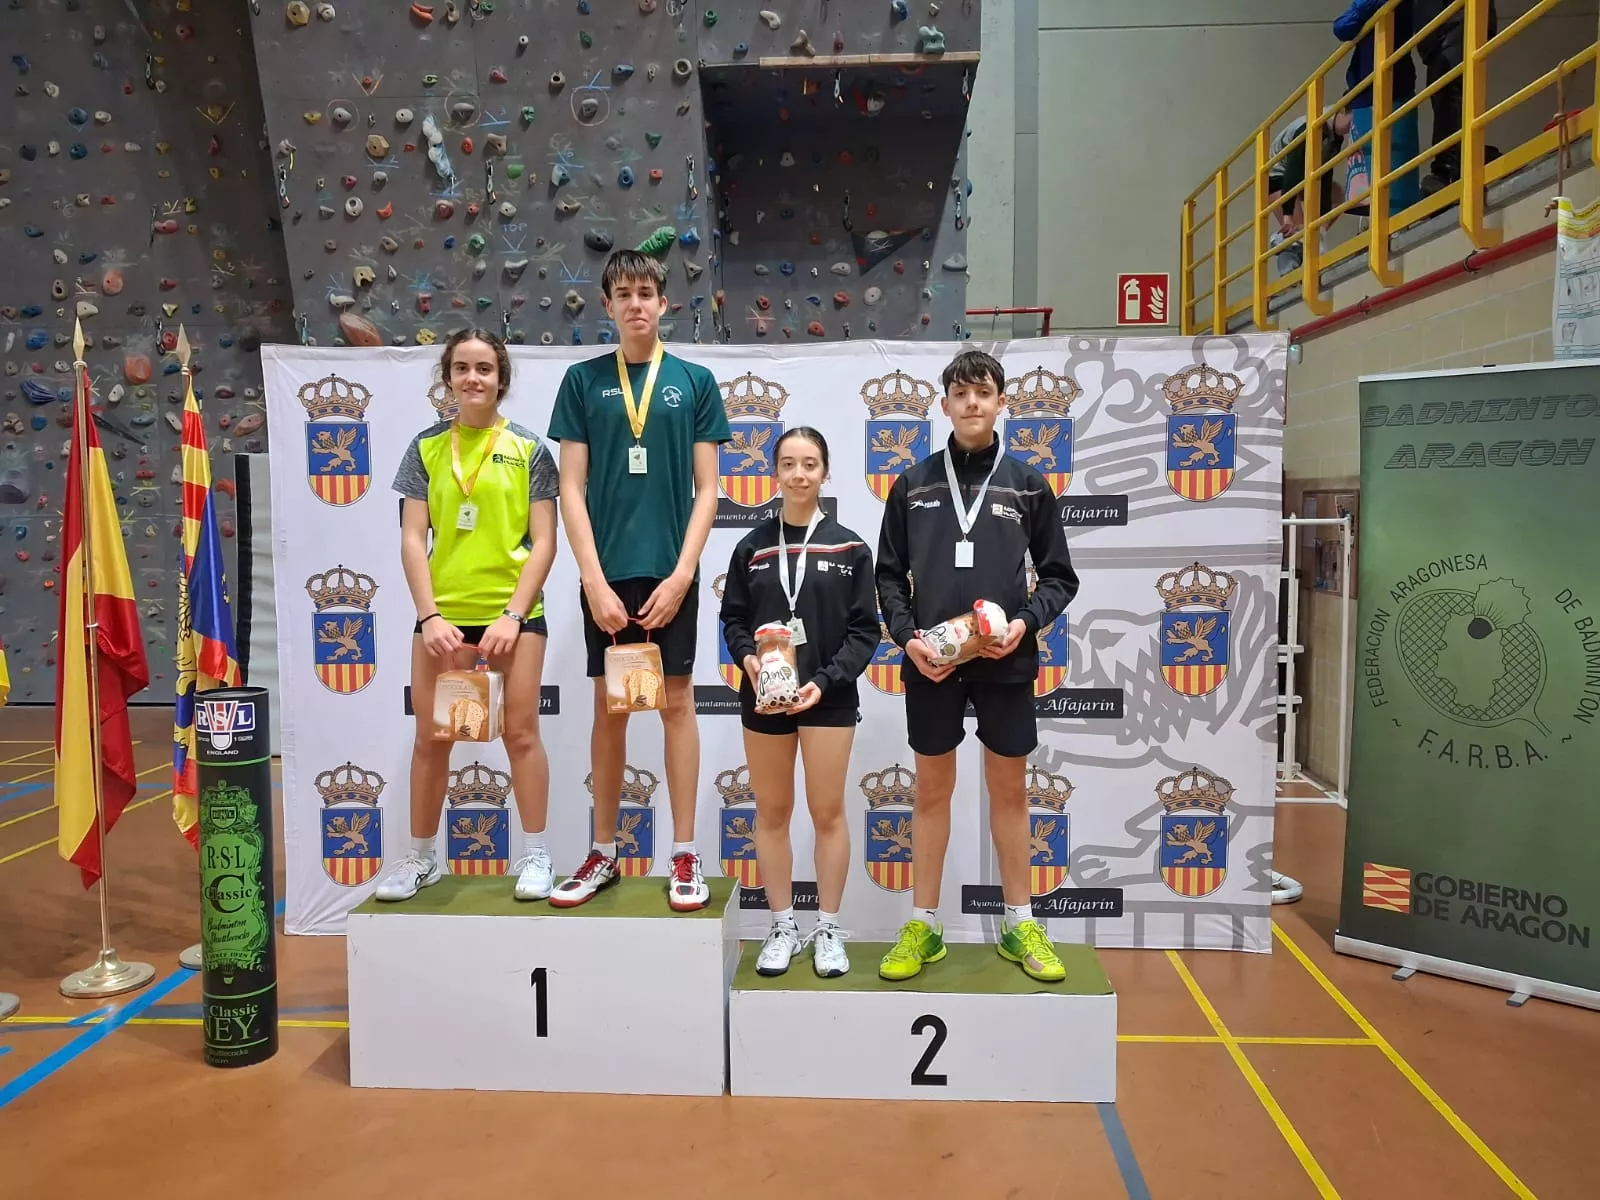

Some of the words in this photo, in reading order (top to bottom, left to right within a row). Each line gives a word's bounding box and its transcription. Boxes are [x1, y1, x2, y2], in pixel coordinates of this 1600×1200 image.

[1361, 394, 1600, 428] BADMINTO
[1384, 438, 1596, 469] ARAGON
[748, 511, 758, 520] de
[1061, 505, 1120, 523] lfajarín
[1364, 608, 1391, 708] FEDERACION
[1390, 553, 1488, 604] ARAGONESA
[1554, 588, 1583, 614] DE
[197, 710, 252, 726] RSL
[1417, 729, 1549, 769] F.A.R.B.A.
[204, 886, 253, 900] Classic
[1414, 872, 1568, 918] GOBIERNO
[1413, 895, 1449, 921] DE
[1460, 905, 1590, 948] ARAGON
[209, 1004, 258, 1017] Classic
[530, 968, 548, 1037] 1
[911, 1014, 948, 1086] 2
